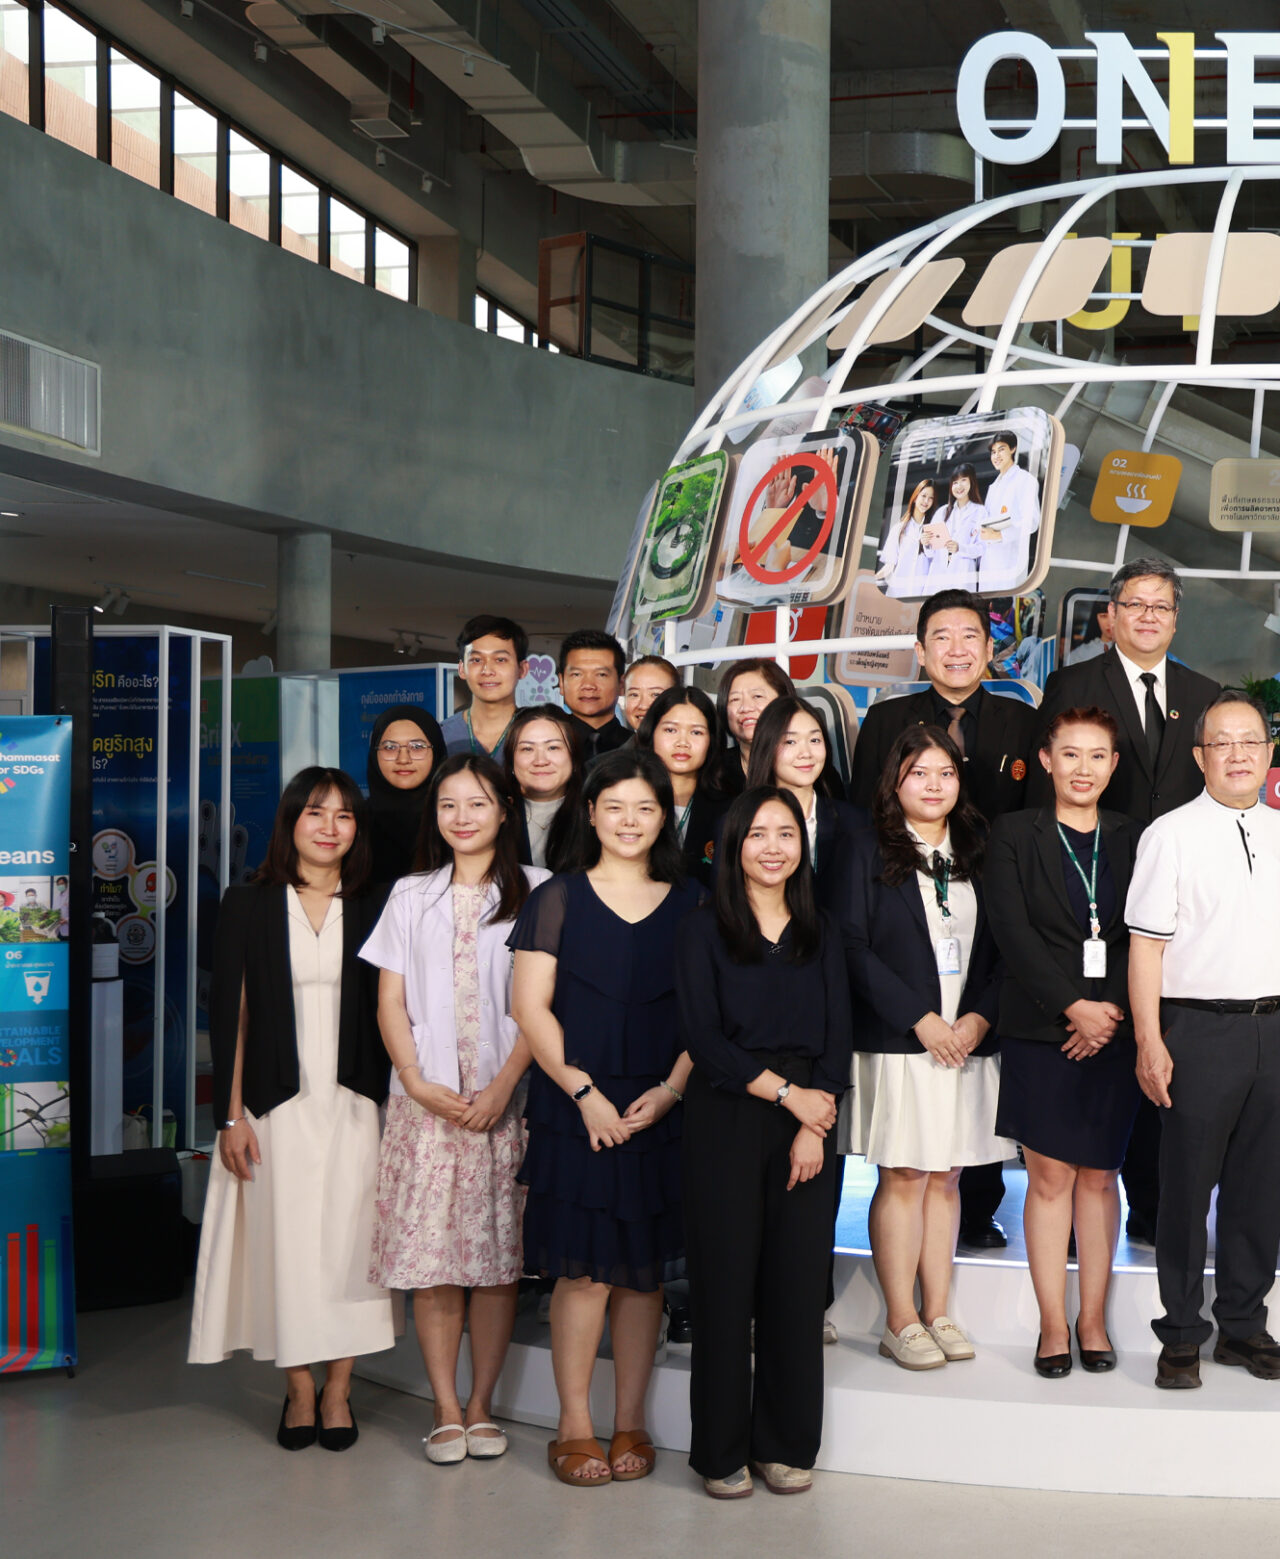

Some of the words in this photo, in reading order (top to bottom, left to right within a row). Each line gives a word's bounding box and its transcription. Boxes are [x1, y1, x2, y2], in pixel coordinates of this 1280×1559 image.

[1112, 458, 1128, 468] 02
[1269, 469, 1280, 486] 2
[856, 611, 882, 625] เป้าหมาย
[13, 766, 45, 775] SDGs
[5, 950, 23, 960] 06
